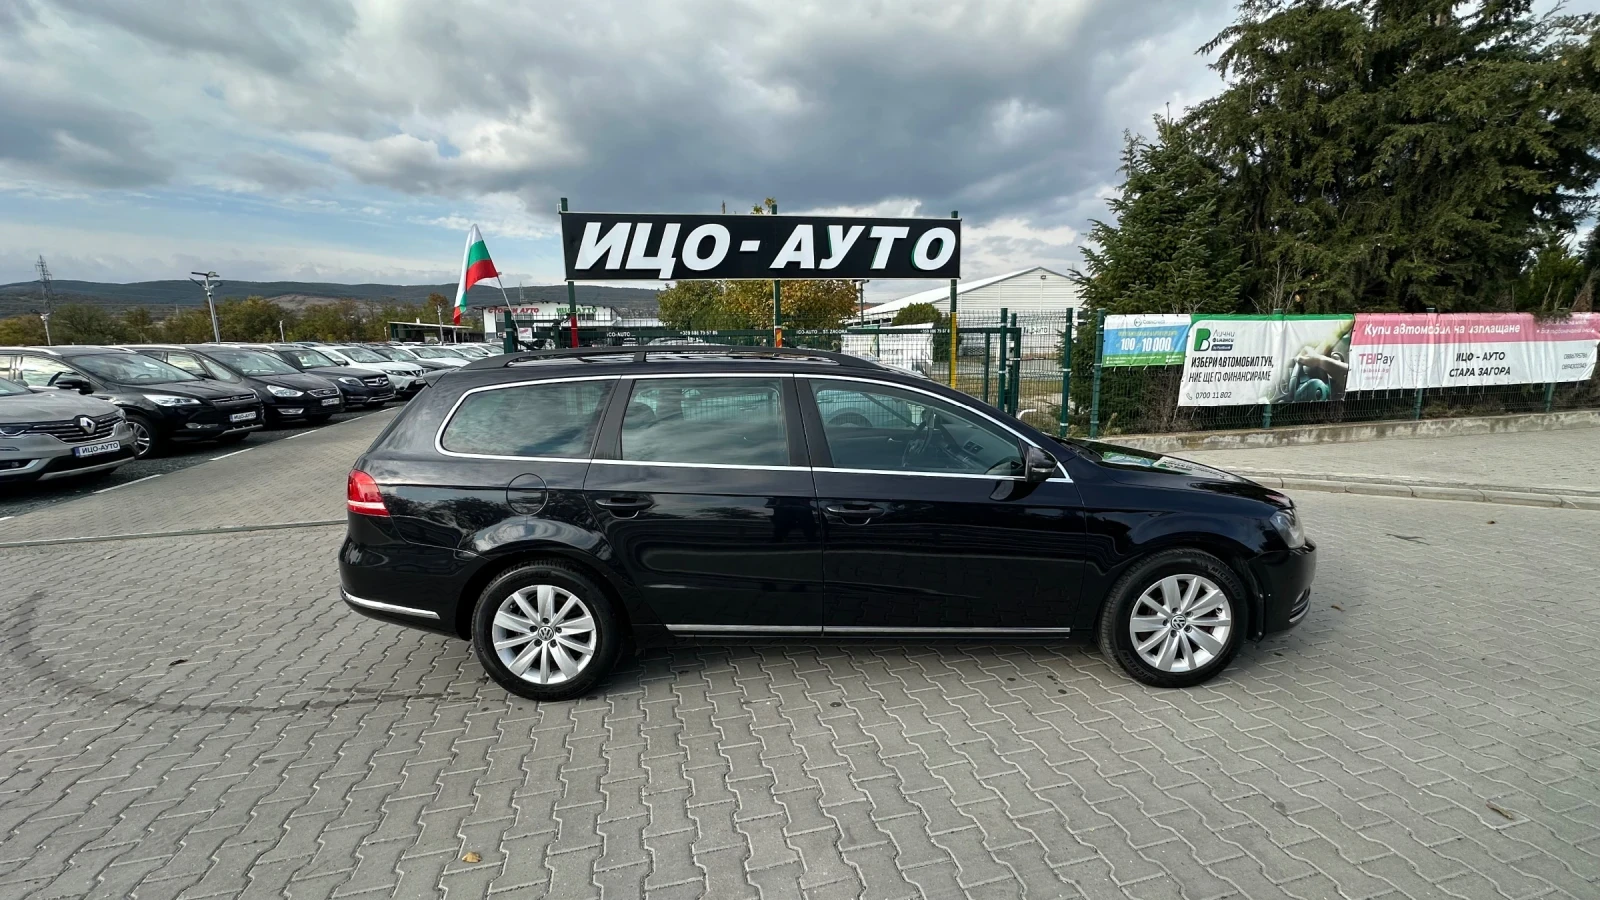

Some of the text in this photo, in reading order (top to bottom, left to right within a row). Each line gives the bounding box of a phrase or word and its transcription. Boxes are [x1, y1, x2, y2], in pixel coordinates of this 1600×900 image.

[574, 221, 731, 279] ИЦО
[769, 224, 957, 271] АУТО
[1213, 329, 1235, 338] Лични
[1364, 323, 1391, 337] Купи
[1393, 323, 1451, 336] автомобил
[1454, 325, 1465, 334] на
[1121, 338, 1136, 351] 100
[1191, 355, 1274, 368] ИЗБЕРИ АВТОМОБИЛ ТУК,
[1455, 351, 1474, 363] ИЦО
[1481, 351, 1506, 361] АУТО
[1188, 372, 1203, 383] НИЕ
[1203, 372, 1214, 384] ЩЕ
[1222, 370, 1272, 382] ФИНАНСИРАМЕ
[1449, 366, 1511, 378] СТАРА ЗАГОРА
[234, 412, 257, 421] ИЦО-АУТО
[82, 442, 119, 455] ИЦО-АУТО
[1210, 566, 1242, 598] MICHELIN
[1122, 650, 1155, 682] MICHELIN
